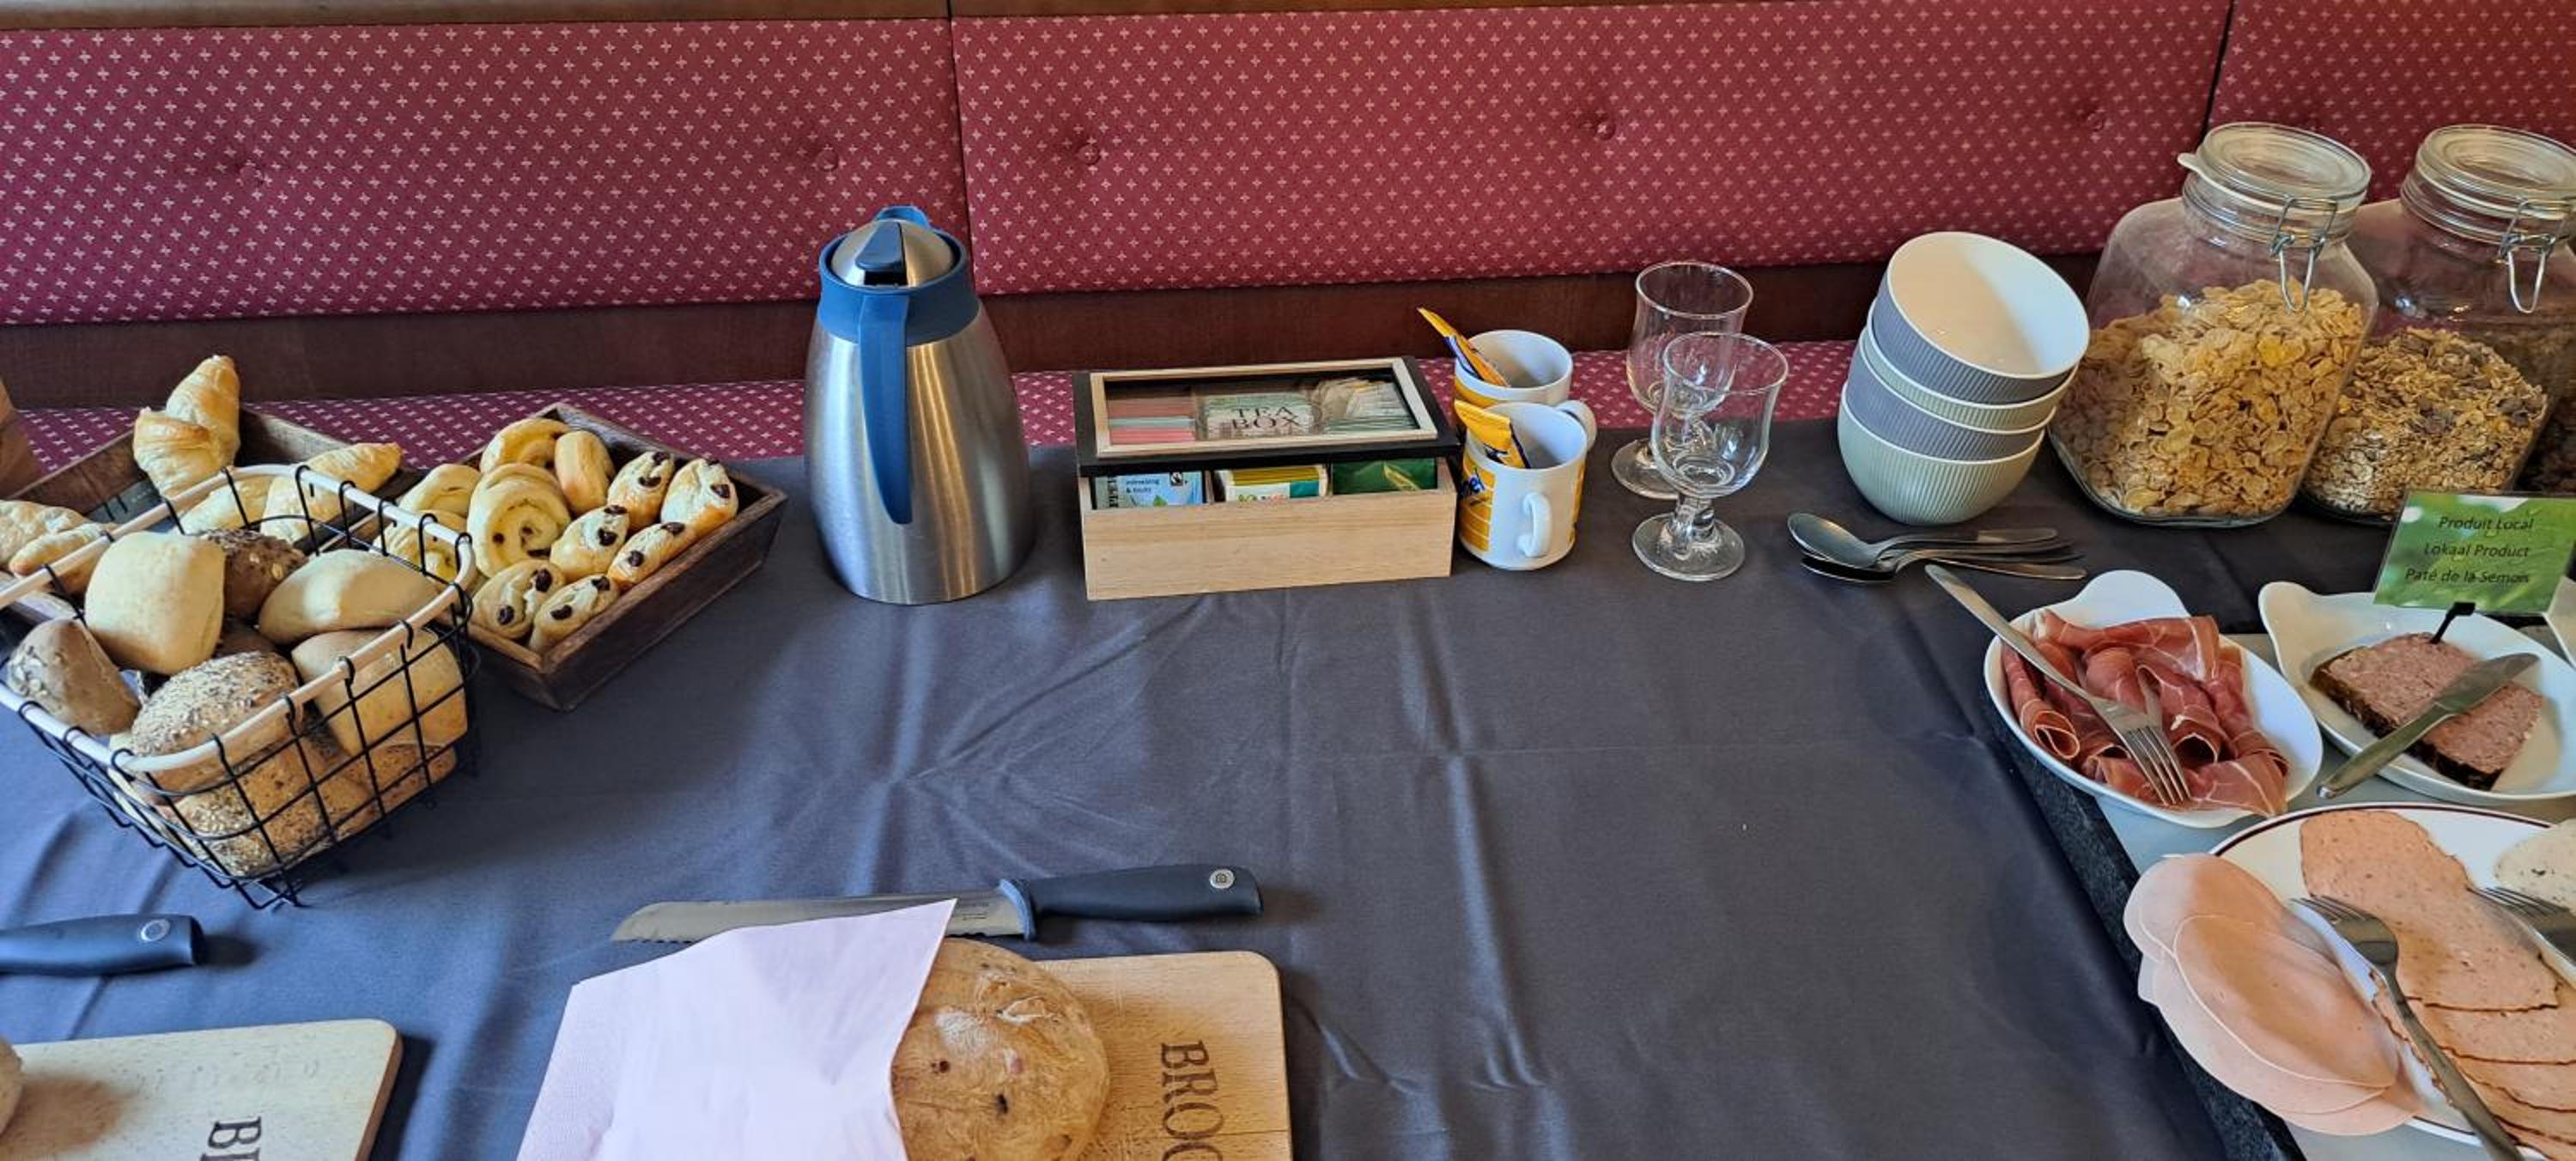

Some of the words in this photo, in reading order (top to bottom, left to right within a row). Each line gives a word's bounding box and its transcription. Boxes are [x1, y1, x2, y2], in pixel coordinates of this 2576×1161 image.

[1231, 406, 1298, 418] TEA
[1232, 416, 1303, 429] BOX
[2439, 517, 2492, 530] Produit
[2497, 518, 2534, 530] Local
[2424, 543, 2472, 556] Lokaal
[2474, 544, 2529, 557] Product
[2441, 568, 2460, 582] de
[2464, 570, 2476, 583] la
